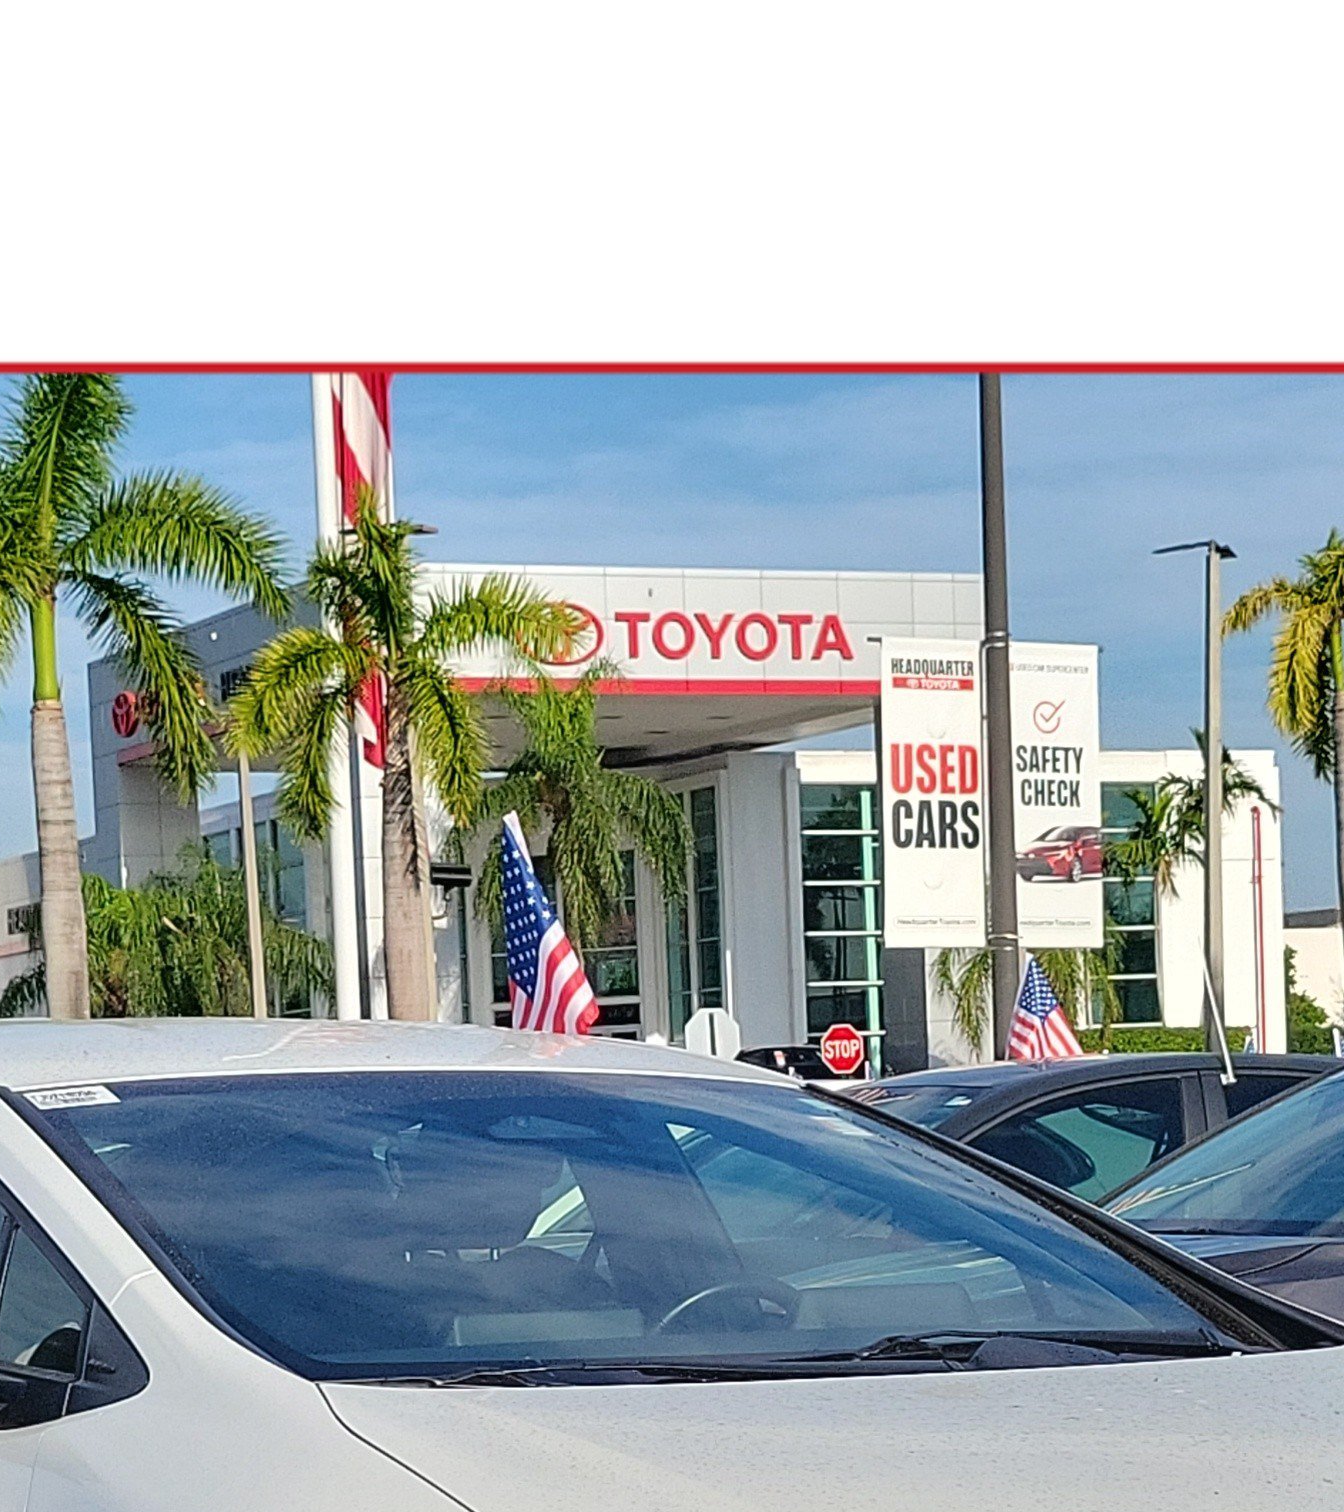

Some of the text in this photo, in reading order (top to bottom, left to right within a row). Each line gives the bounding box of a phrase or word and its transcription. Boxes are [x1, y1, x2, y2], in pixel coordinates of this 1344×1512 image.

[614, 611, 854, 661] TOYOTA
[891, 658, 974, 678] HEADQUARTER
[920, 679, 960, 690] TOYOTA
[891, 743, 978, 794] USED
[1016, 745, 1083, 773] SAFETY
[1020, 779, 1081, 807] CHECK
[892, 799, 980, 849] CARS
[825, 1039, 860, 1059] STOP
